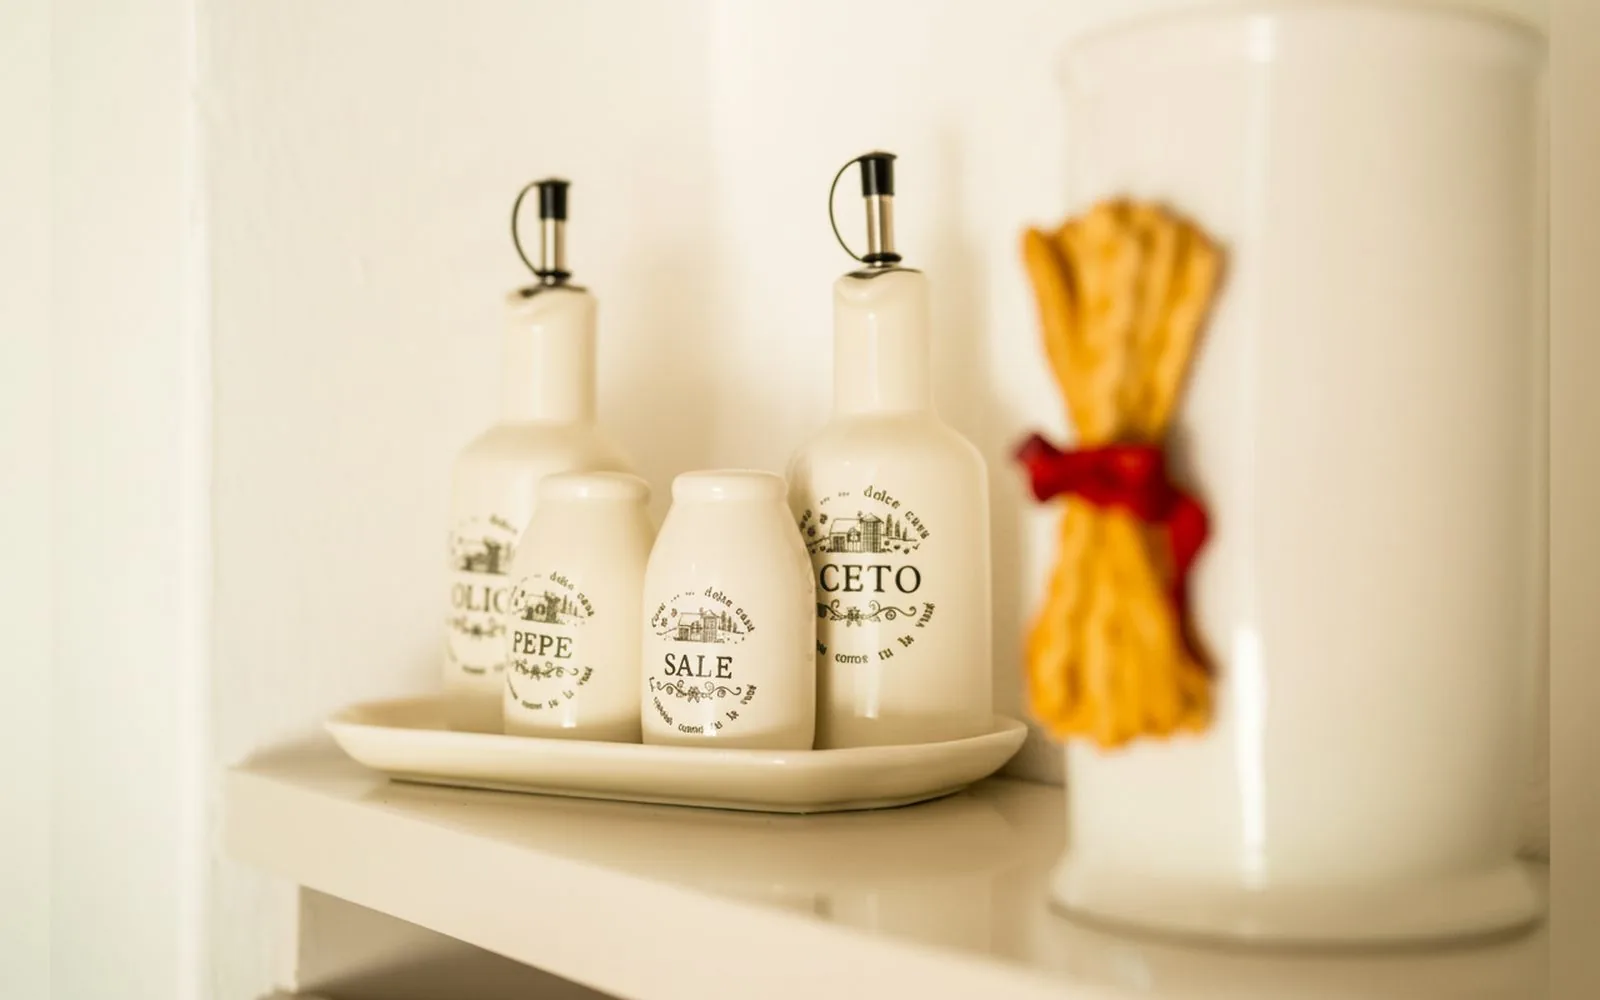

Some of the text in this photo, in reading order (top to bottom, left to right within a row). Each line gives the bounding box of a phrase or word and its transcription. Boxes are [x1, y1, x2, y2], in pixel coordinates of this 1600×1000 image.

[819, 564, 921, 594] CETO
[513, 630, 573, 659] PEPE
[664, 652, 733, 679] SALE
